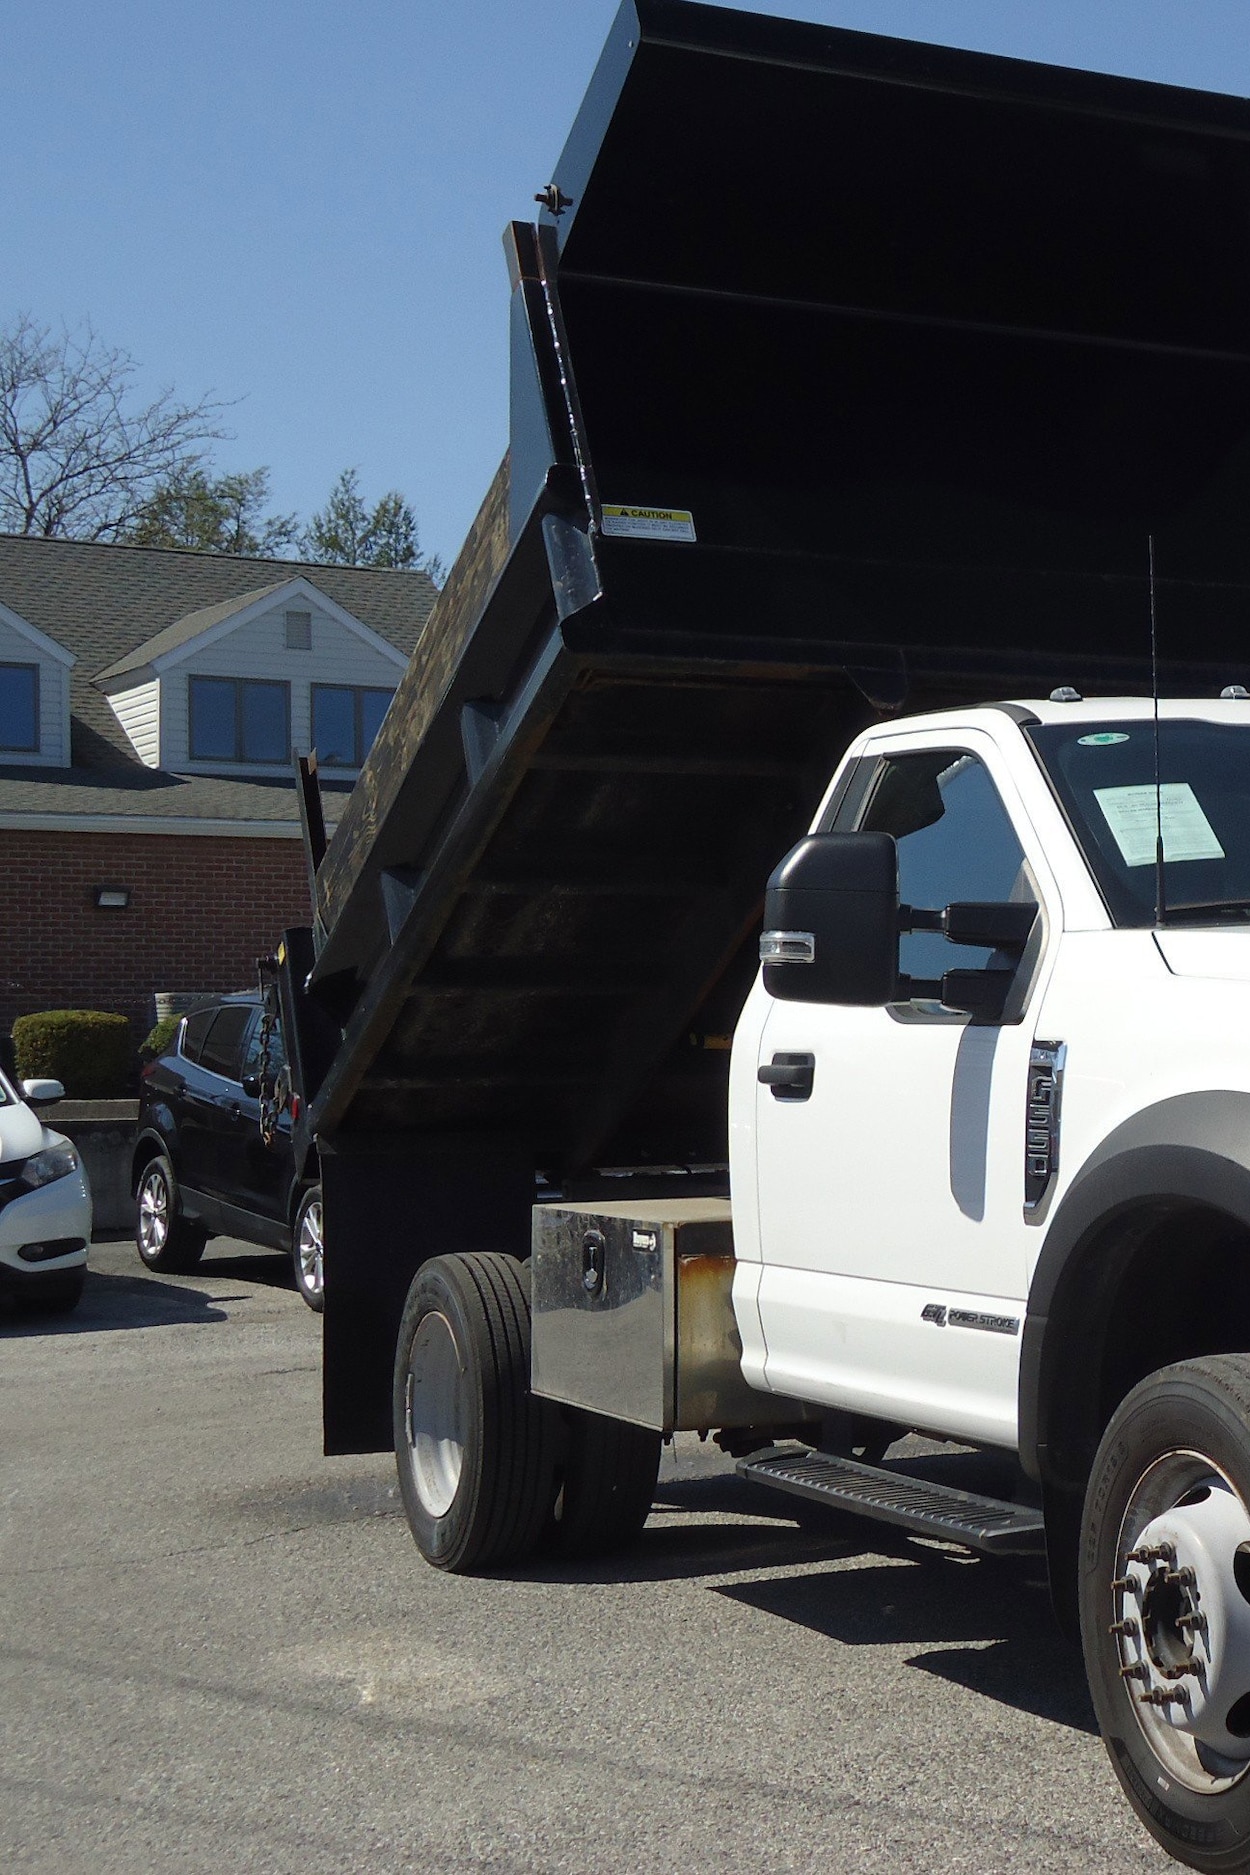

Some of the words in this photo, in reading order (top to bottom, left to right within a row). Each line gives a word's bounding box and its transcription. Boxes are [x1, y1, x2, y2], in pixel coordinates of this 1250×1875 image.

[631, 509, 673, 520] CAUTION
[949, 1310, 979, 1324] POWER
[979, 1314, 1015, 1329] STROKE
